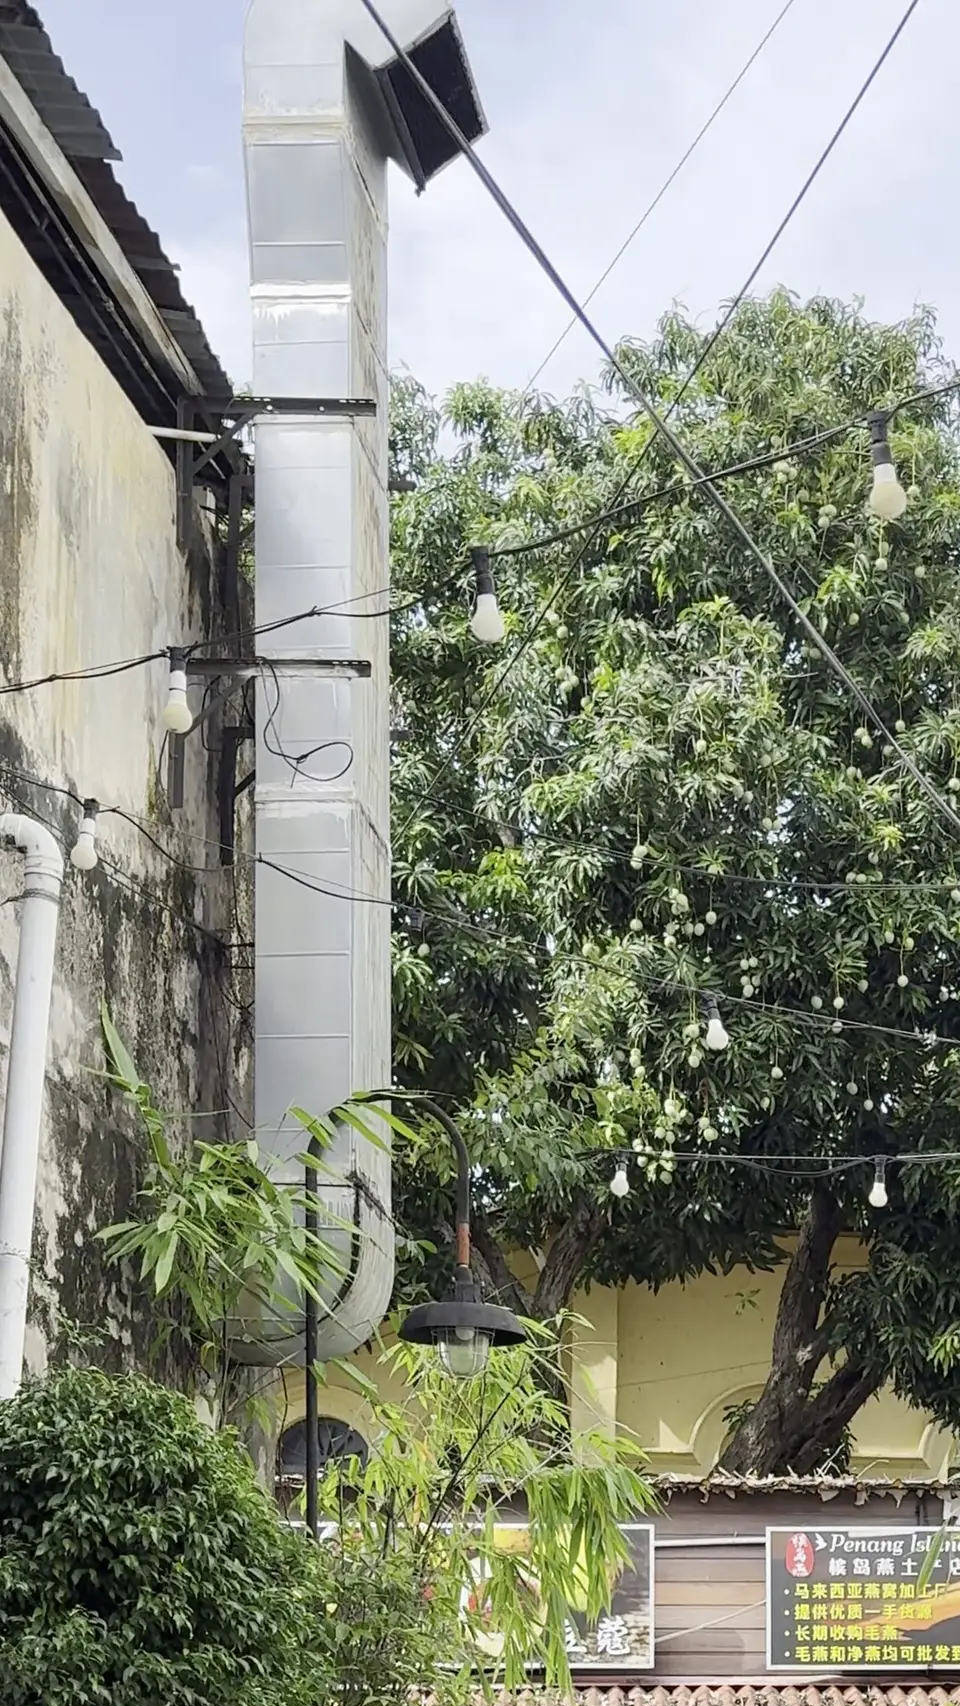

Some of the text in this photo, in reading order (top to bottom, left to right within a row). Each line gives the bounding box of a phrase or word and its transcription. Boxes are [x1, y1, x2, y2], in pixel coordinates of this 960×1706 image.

[829, 1533, 905, 1555] Penang
[794, 1582, 947, 1600] 马来西亚燕窝加工厂
[794, 1603, 933, 1620] 提供优质一手货源
[795, 1625, 897, 1641] 长期收购毛燕
